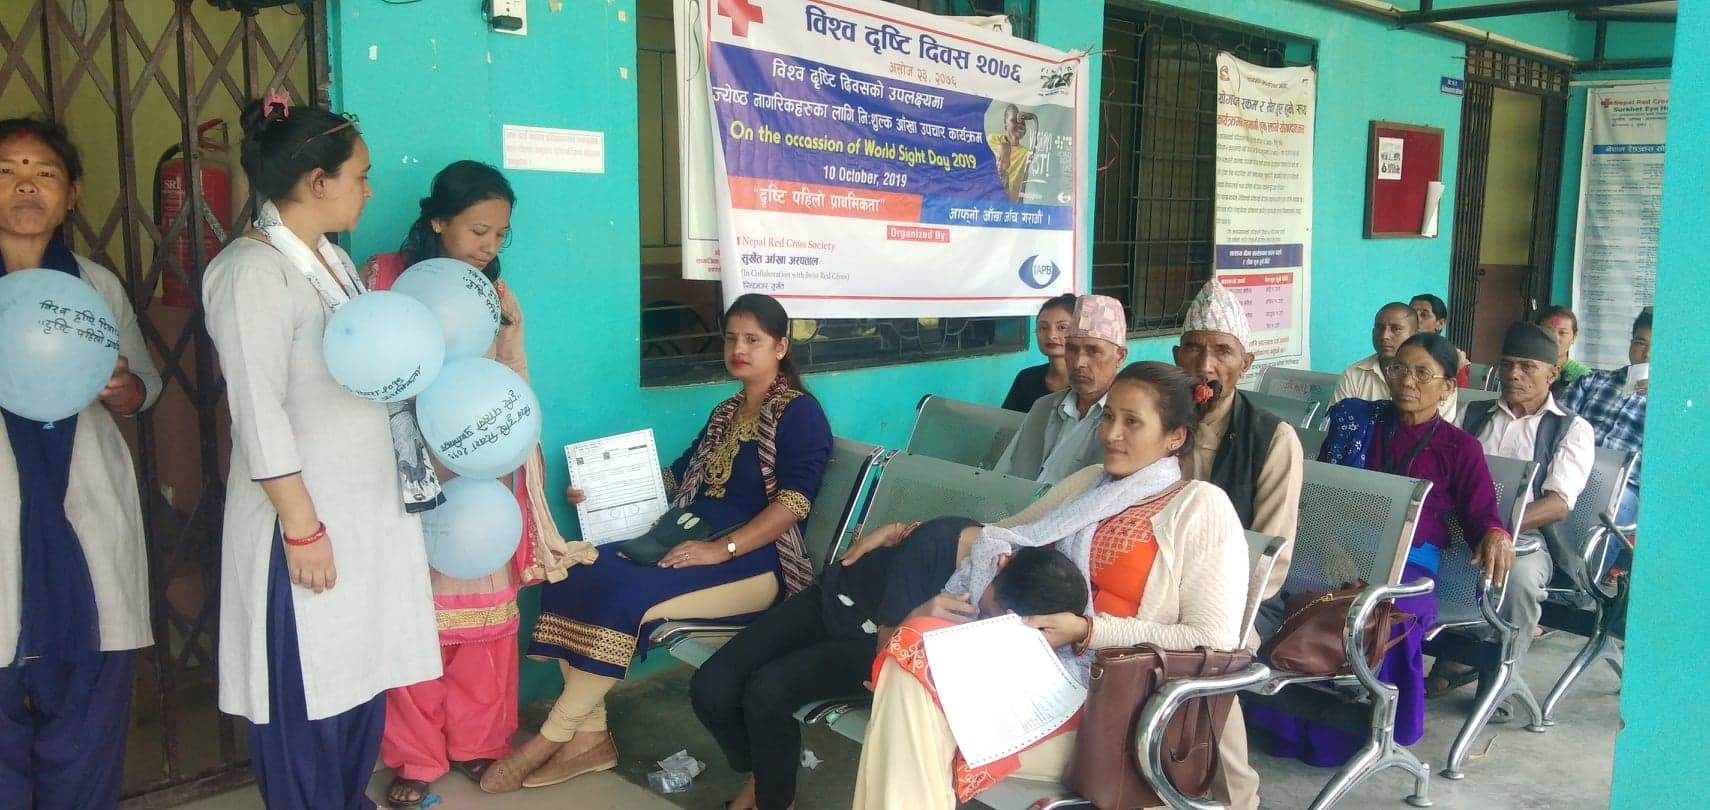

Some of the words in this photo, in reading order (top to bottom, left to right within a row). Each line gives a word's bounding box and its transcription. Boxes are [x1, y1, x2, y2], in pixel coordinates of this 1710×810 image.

[805, 5, 857, 42] विश्व
[865, 25, 912, 55] दृष्टि
[919, 34, 970, 70] दिवस
[976, 55, 1022, 83] २०७६
[772, 58, 805, 81] विश्व
[810, 67, 836, 89] दृष्टि
[840, 73, 884, 98] दिवसको
[888, 86, 944, 109] उपलक्ष्यमा
[712, 84, 749, 105] ज्येष्ठ
[832, 104, 854, 122] लागि
[920, 122, 946, 139] उपचार
[948, 127, 983, 143] कार्यक्रम
[730, 121, 753, 140] On
[759, 125, 781, 144] the
[785, 135, 843, 152] occassion
[847, 138, 861, 154] of
[864, 139, 895, 159] World
[899, 144, 926, 167] Sight
[928, 149, 951, 171] Day
[952, 152, 977, 169] 2019
[824, 165, 836, 180] 10
[839, 166, 880, 187] October,
[883, 172, 907, 188] 2019
[792, 187, 825, 208] पहिलो
[742, 236, 766, 248] Nepal
[768, 237, 785, 248] Red
[786, 239, 807, 249] Cross
[808, 240, 836, 253] Society
[891, 228, 932, 240] Organized
[792, 270, 804, 278] with
[1034, 265, 1052, 275] IAPB
